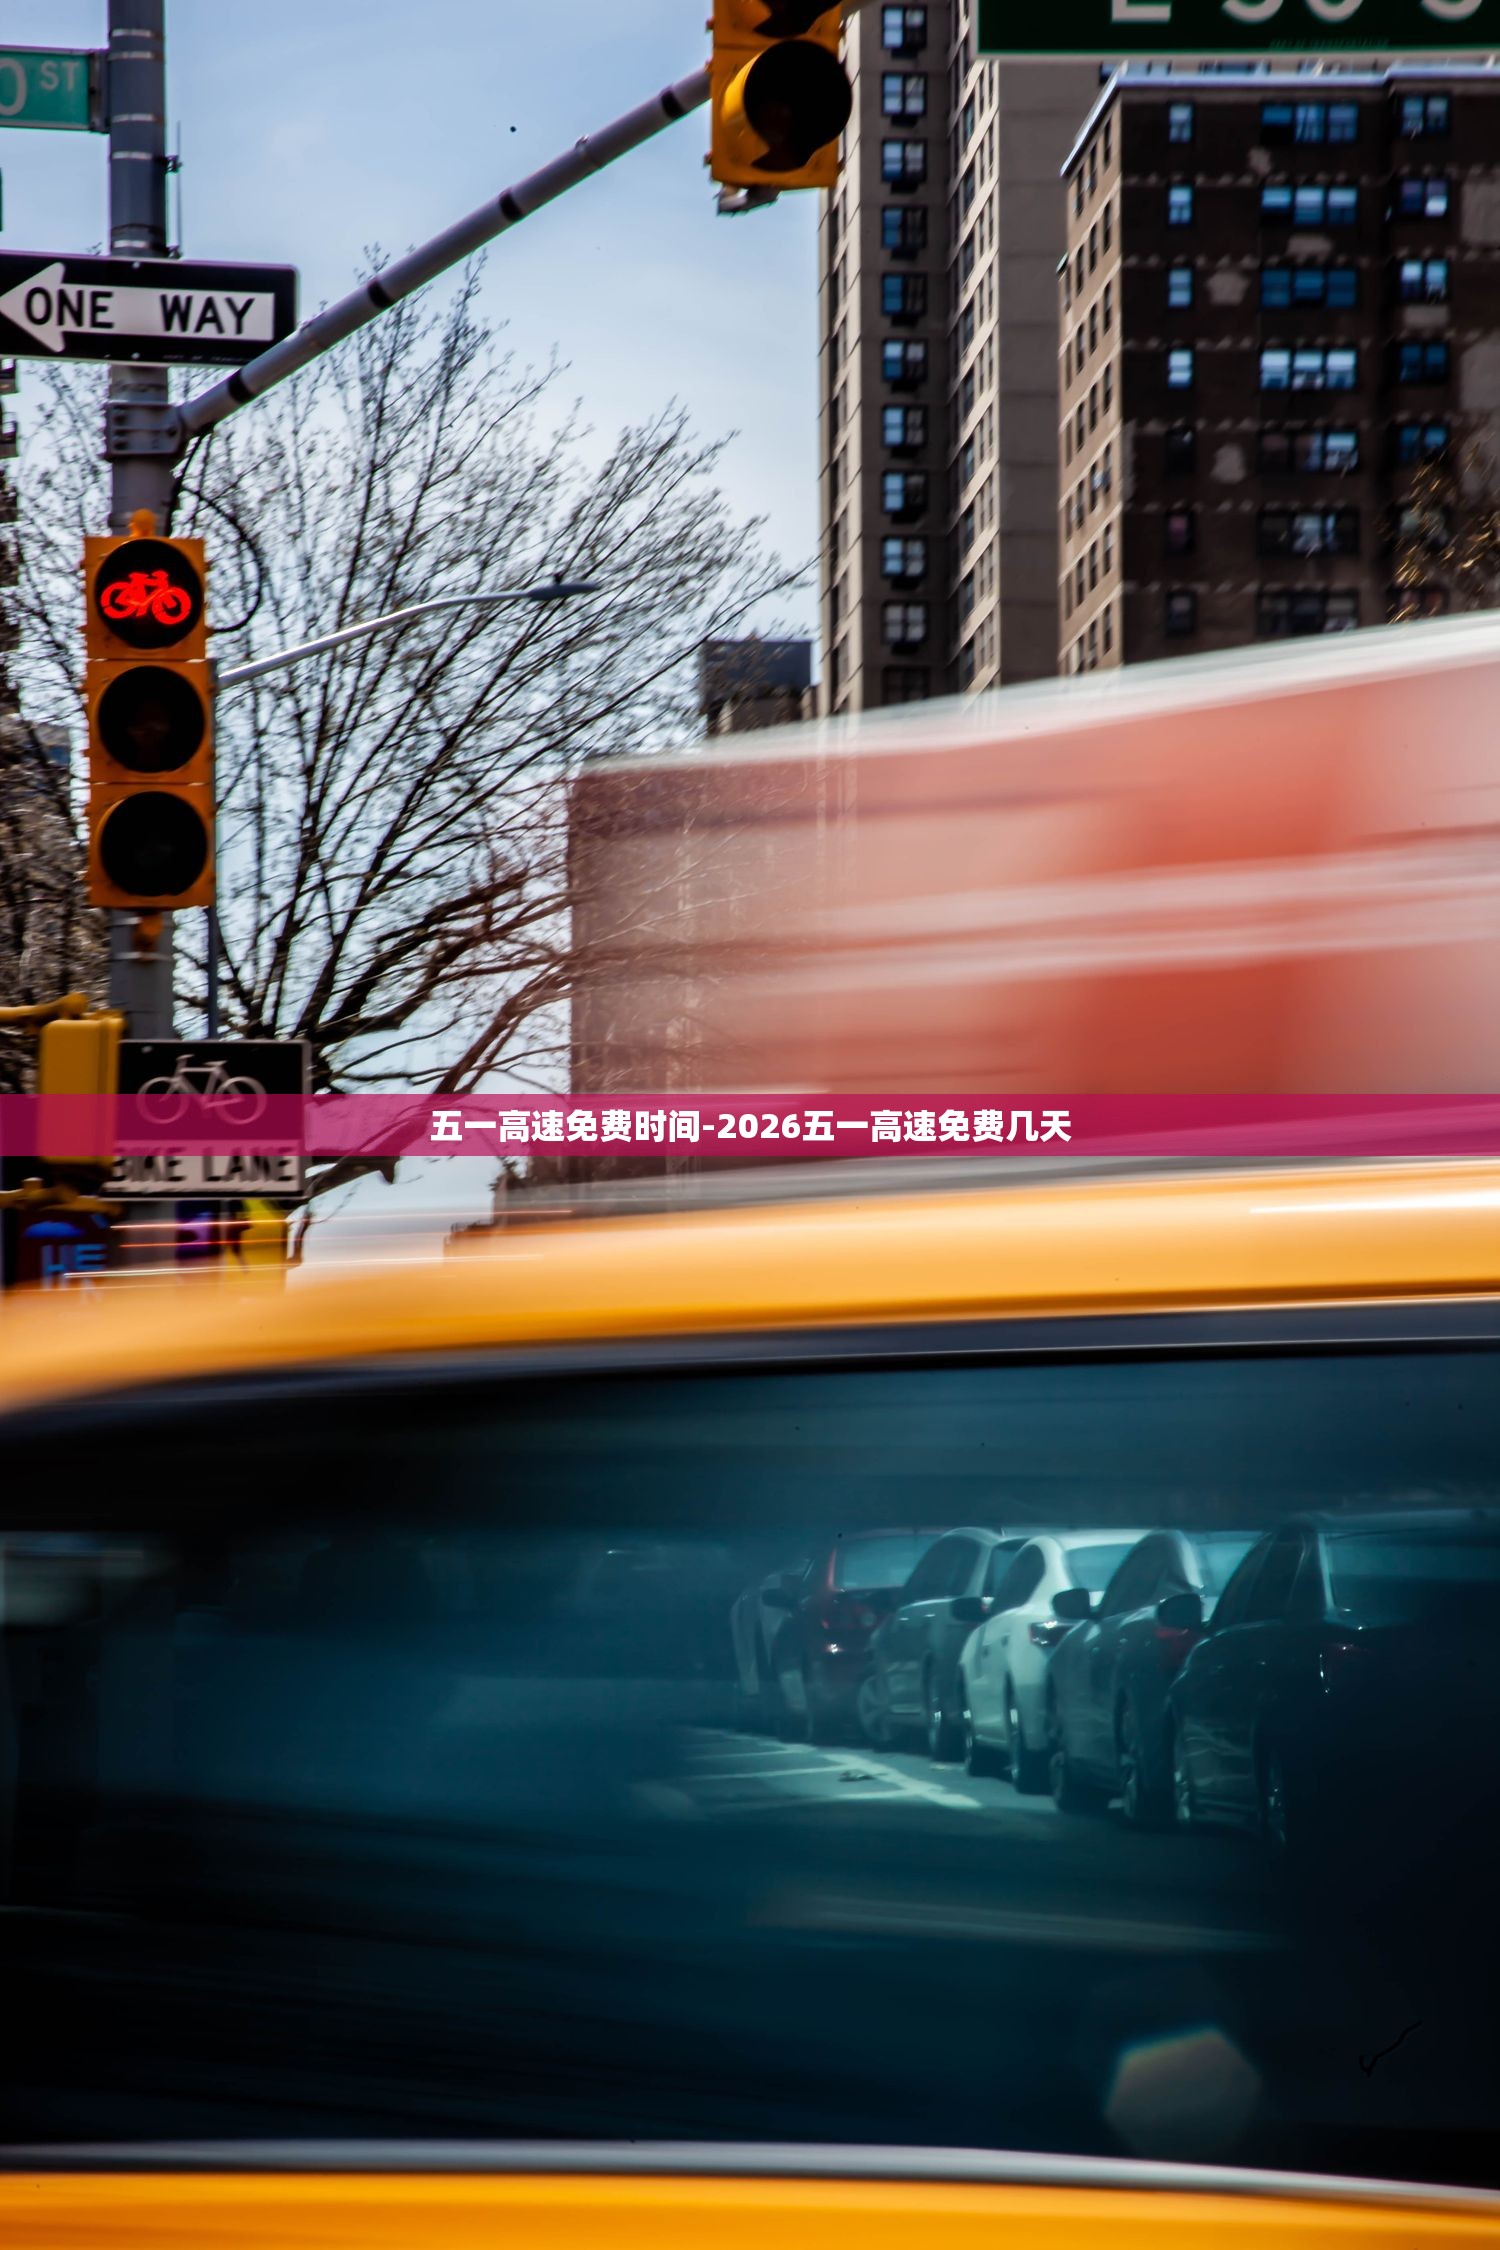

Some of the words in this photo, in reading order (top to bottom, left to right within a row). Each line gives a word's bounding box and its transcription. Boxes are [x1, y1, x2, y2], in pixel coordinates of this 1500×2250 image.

[39, 61, 81, 92] ST
[25, 286, 114, 328] ONE
[160, 294, 256, 335] WAY
[111, 1146, 187, 1183] BIKE
[201, 1146, 295, 1183] LANE
